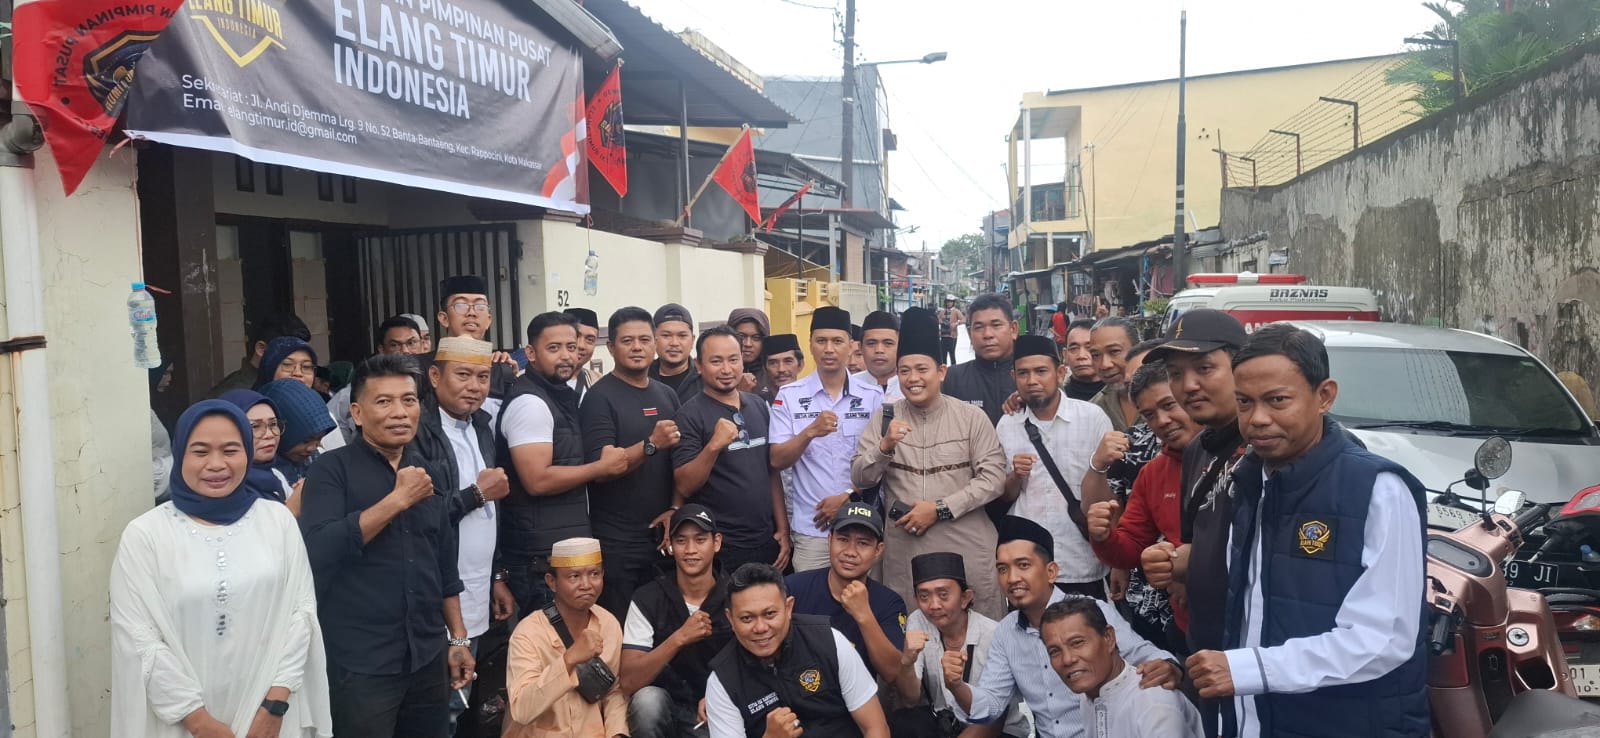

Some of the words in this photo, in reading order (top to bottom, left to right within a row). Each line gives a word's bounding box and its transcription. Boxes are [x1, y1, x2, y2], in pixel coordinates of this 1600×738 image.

[217, 17, 257, 39] INDONESIA
[239, 0, 283, 40] TIMUR
[420, 0, 505, 47] PIMPINAN
[508, 30, 552, 67] PUSAT
[334, 0, 444, 71] ELANG
[449, 32, 531, 102] TIMUR
[334, 43, 470, 120] INDONESIA
[251, 94, 263, 108] Jl.
[265, 98, 291, 115] Andi
[293, 104, 336, 125] Djemma
[339, 115, 356, 131] Lrg.
[358, 119, 364, 131] 9
[366, 121, 380, 135] No.
[381, 124, 391, 137] 52
[558, 290, 569, 307] 52
[1270, 288, 1328, 298] BAZNAS
[1533, 565, 1552, 583] JI
